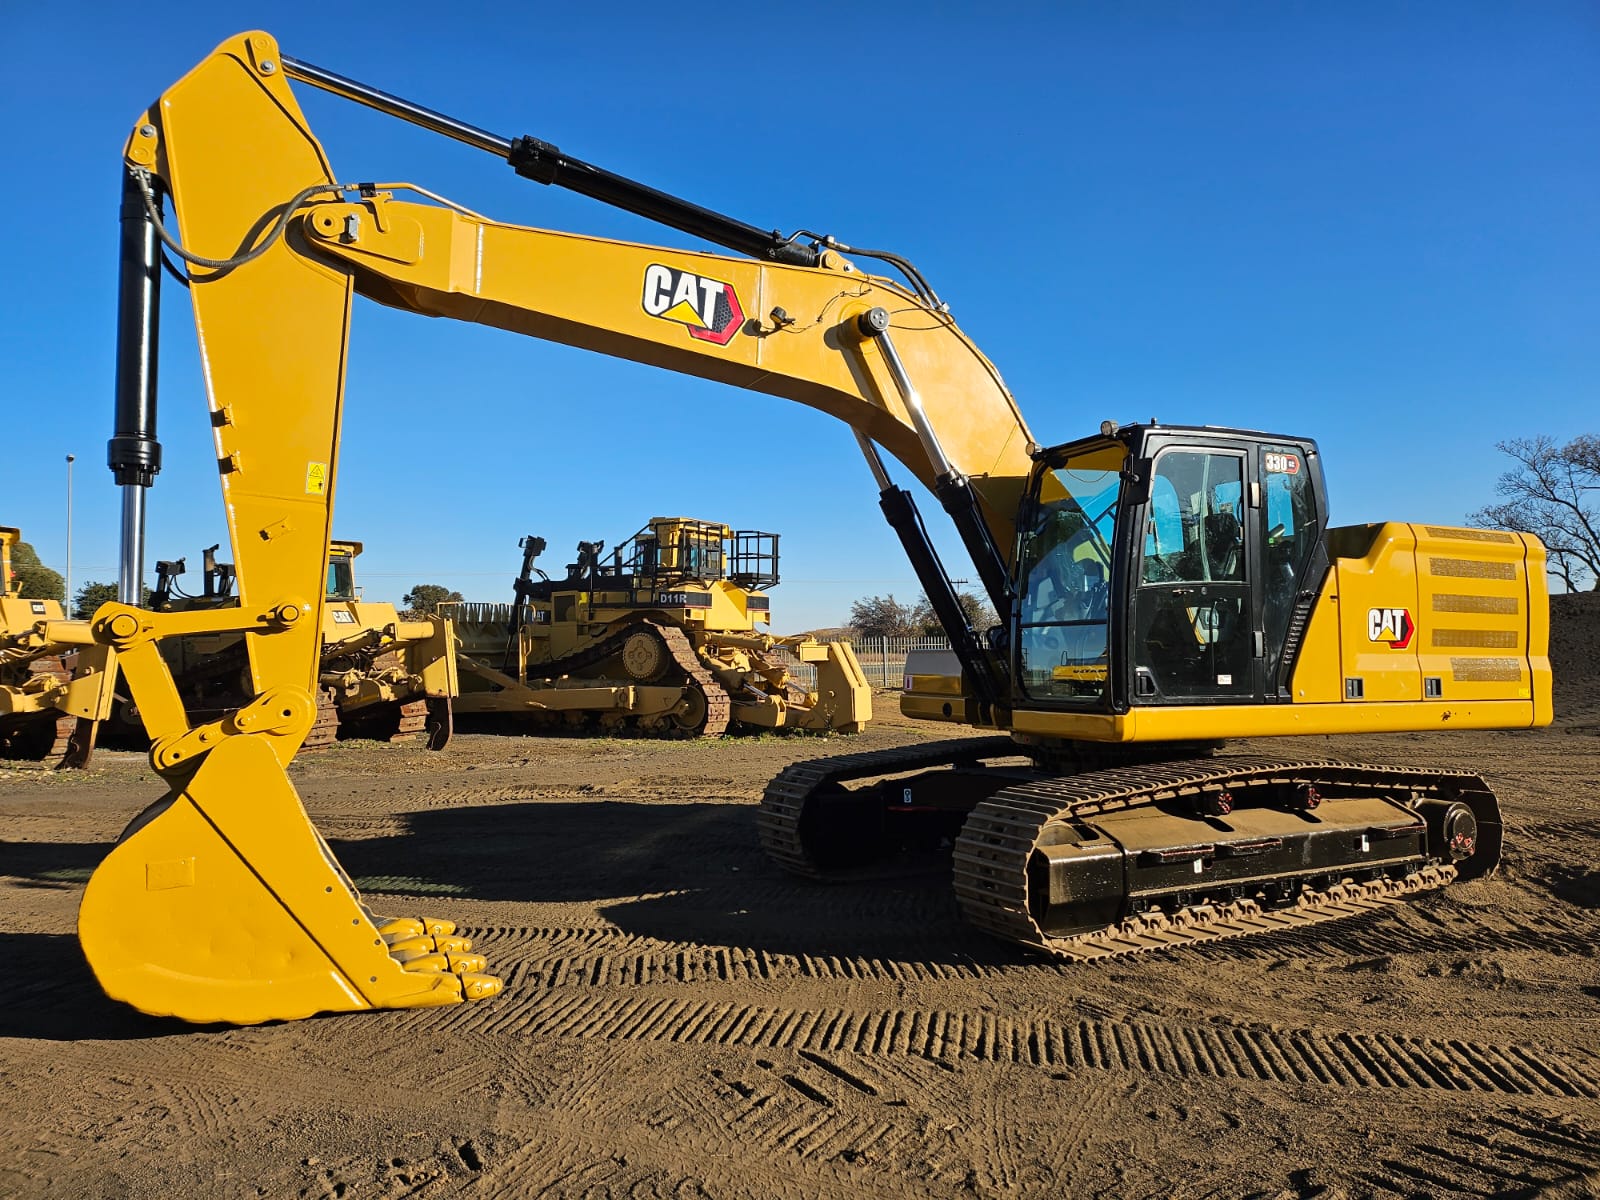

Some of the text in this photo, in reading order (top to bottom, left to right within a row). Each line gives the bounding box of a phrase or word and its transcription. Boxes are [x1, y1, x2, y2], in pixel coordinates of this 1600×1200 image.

[643, 264, 724, 330] CAT
[1265, 454, 1287, 472] 330
[660, 593, 687, 604] D11R
[1368, 609, 1405, 641] CAT
